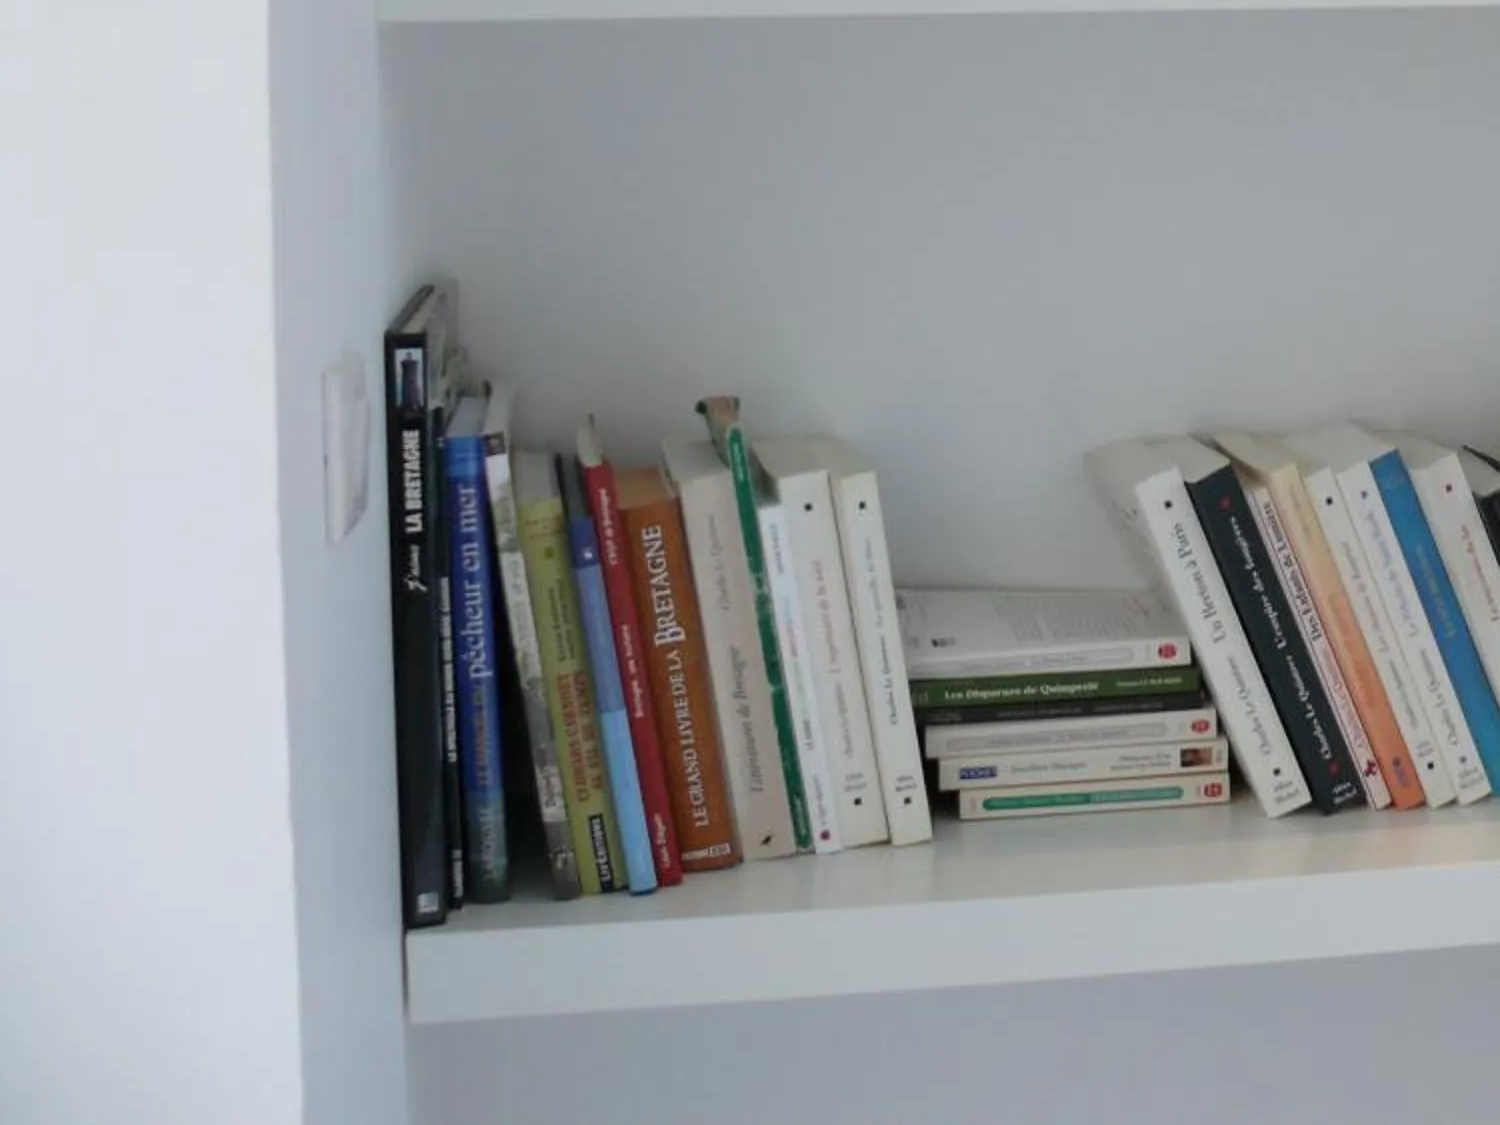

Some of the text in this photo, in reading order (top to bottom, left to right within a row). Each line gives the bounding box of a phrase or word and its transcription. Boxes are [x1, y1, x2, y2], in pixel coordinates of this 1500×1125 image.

[402, 429, 422, 532] LA BRETAGNE
[1167, 521, 1193, 558] Paris
[456, 482, 492, 679] pêcheur en mer
[636, 523, 686, 646] BRETAGNE
[665, 649, 683, 670] LA
[668, 671, 687, 697] DE
[673, 696, 695, 745] LIVRE
[682, 747, 706, 805] GRAND
[691, 805, 709, 827] LE
